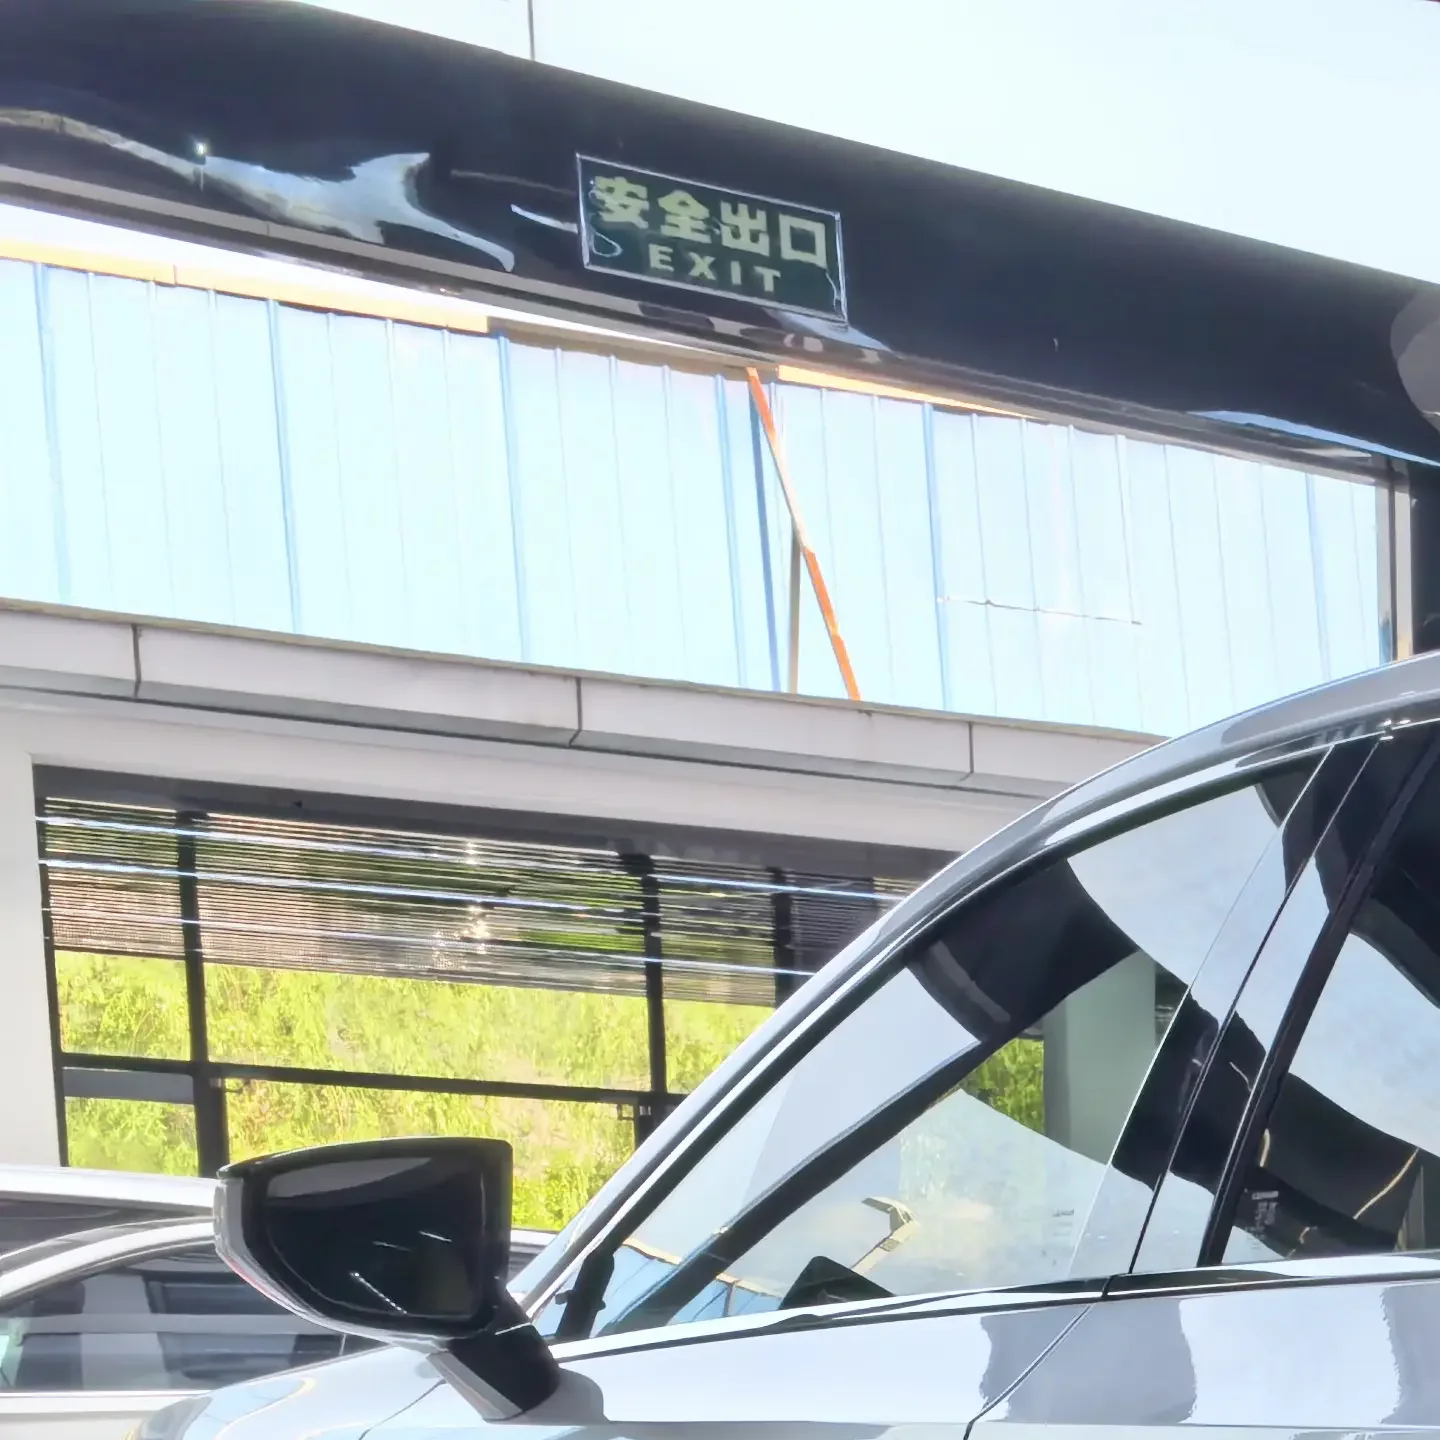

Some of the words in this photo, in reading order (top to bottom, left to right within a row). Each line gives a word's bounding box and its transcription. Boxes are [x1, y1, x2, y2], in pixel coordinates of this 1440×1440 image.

[593, 174, 828, 269] 安全出口
[648, 244, 782, 293] EXIT
